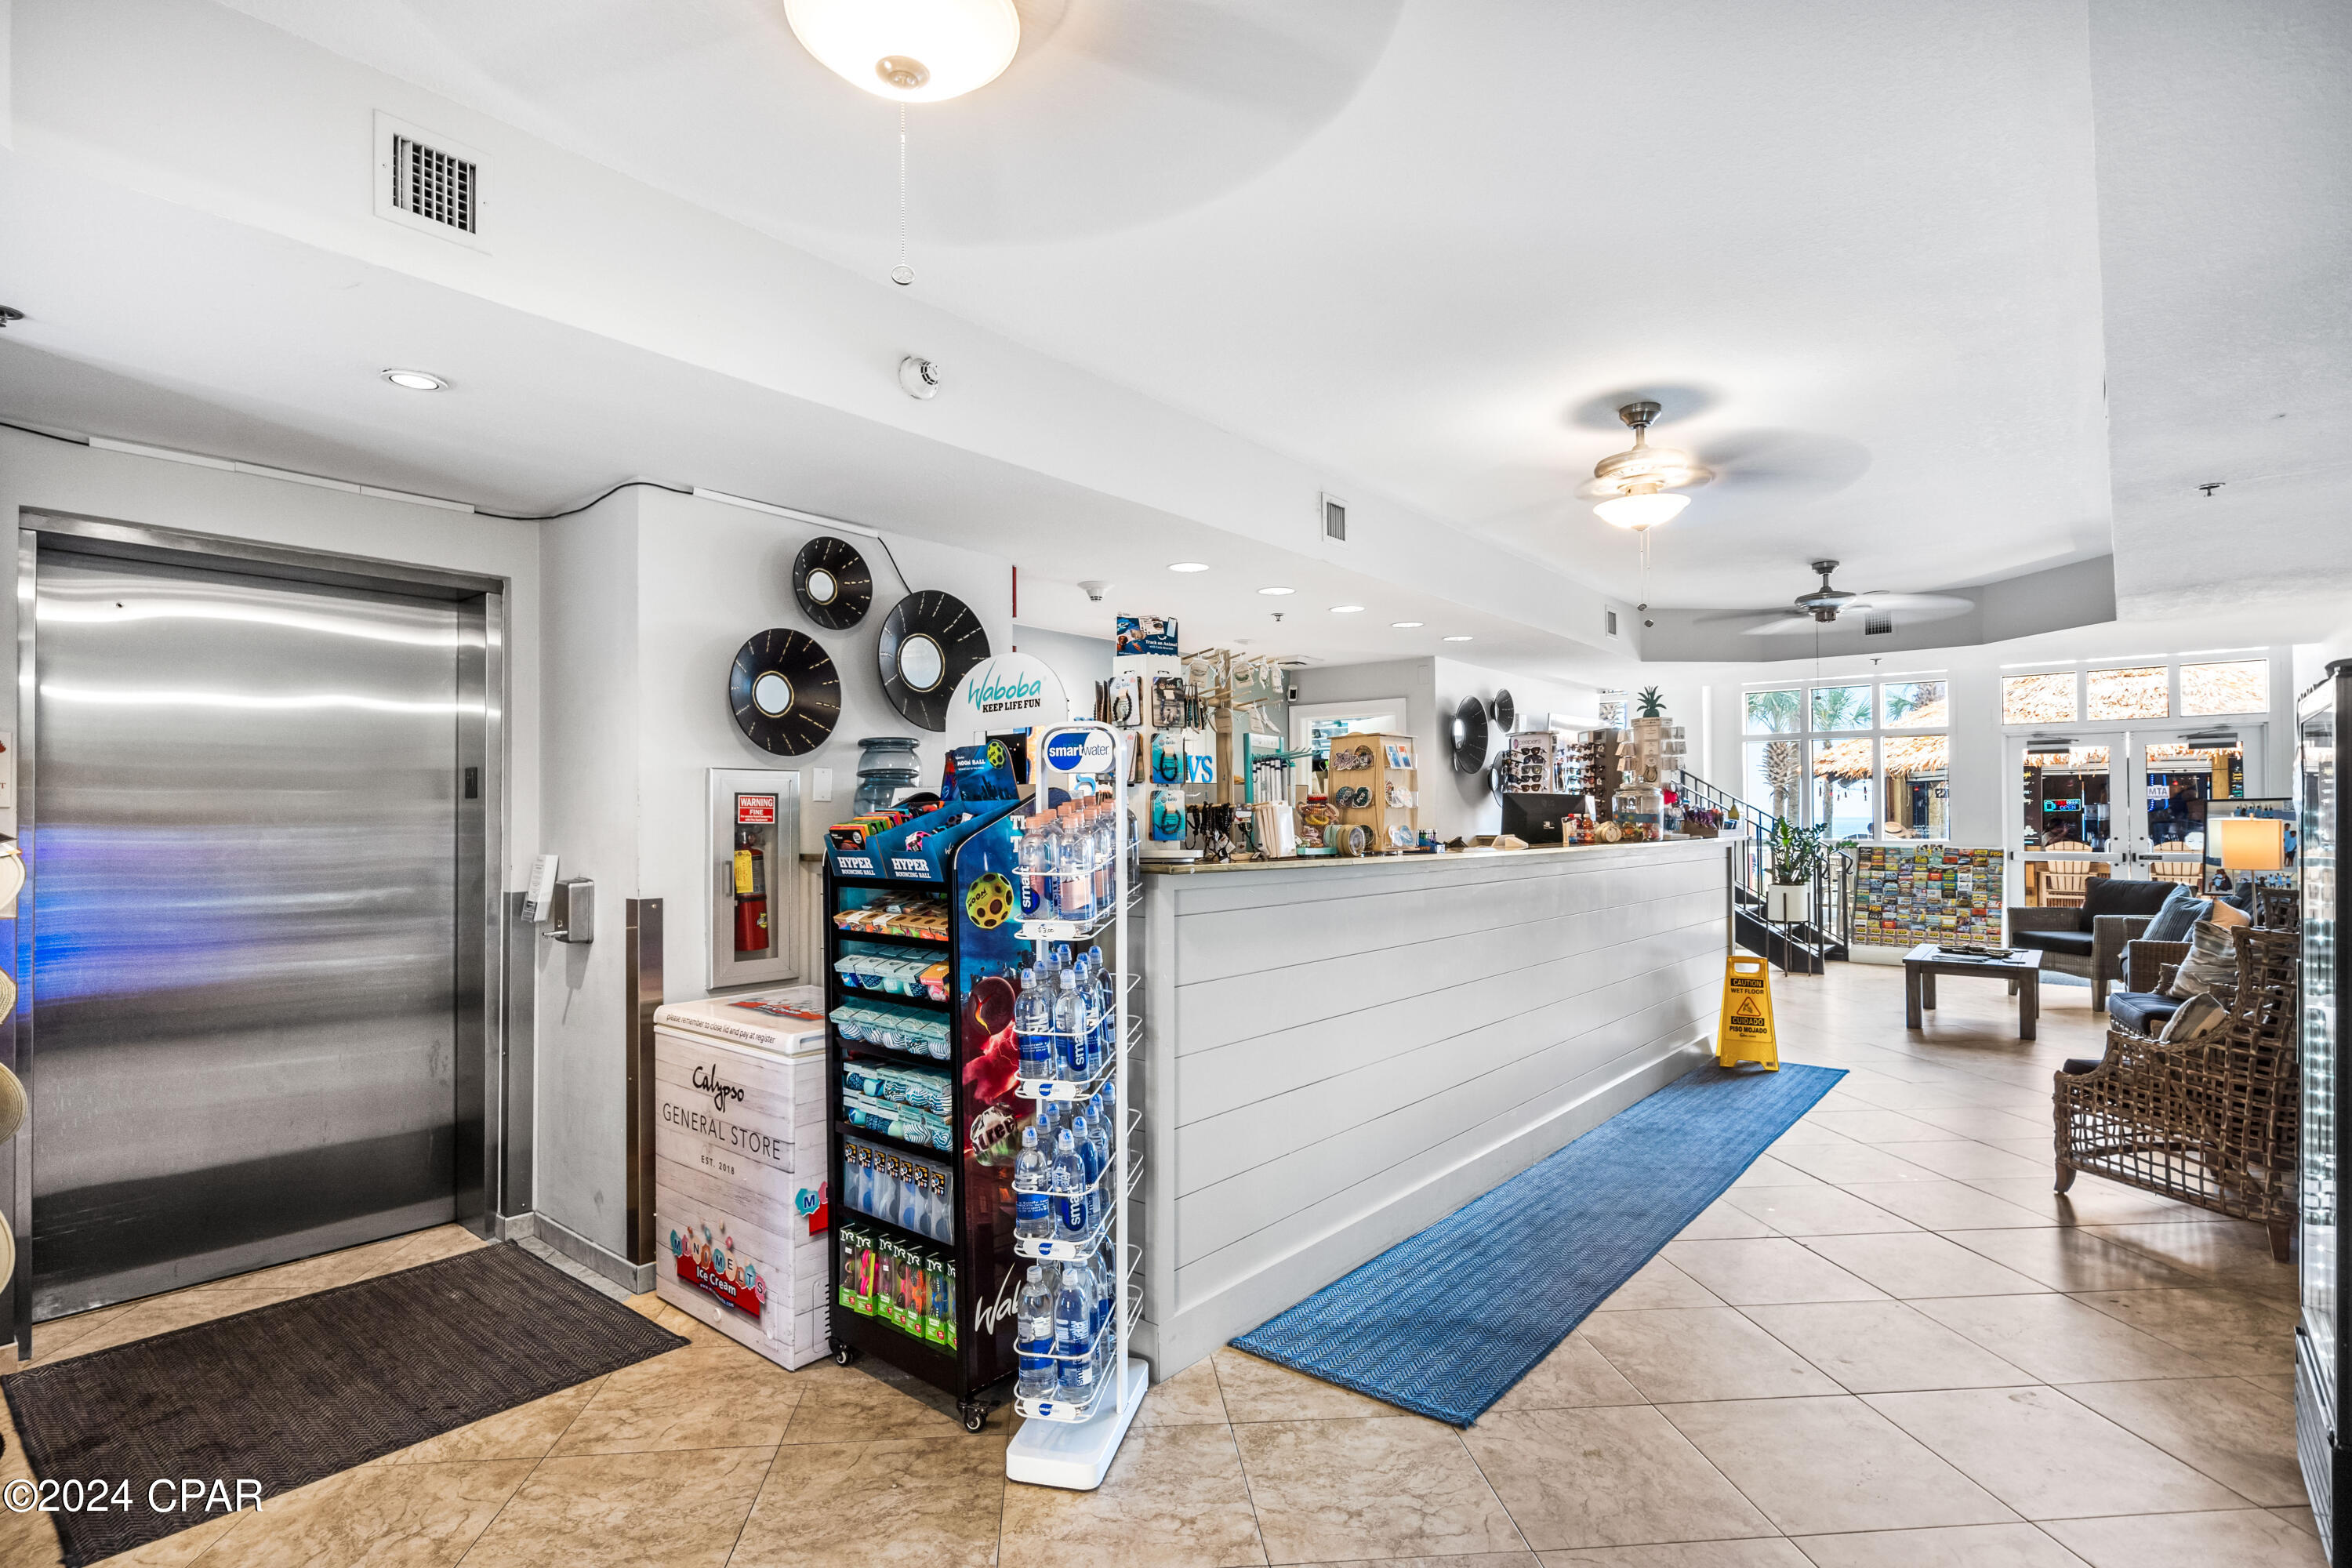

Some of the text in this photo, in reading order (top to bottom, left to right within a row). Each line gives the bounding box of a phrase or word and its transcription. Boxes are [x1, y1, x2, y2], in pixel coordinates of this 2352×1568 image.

[968, 658, 1041, 711] Waboba
[982, 699, 1041, 713] KEEP LIFE FUN
[1049, 744, 1109, 757] smartwater
[740, 797, 773, 807] WARNING
[837, 856, 873, 869] HYPER
[891, 858, 929, 871] HYPER
[1021, 865, 1031, 908] smat
[1733, 978, 1762, 987] CAUTION
[1733, 1017, 1763, 1025] CUIDADO
[681, 1017, 705, 1029] remember
[710, 1023, 722, 1033] close
[729, 1026, 739, 1036] and
[739, 1029, 748, 1040] pay
[756, 1033, 775, 1044] register
[693, 1063, 745, 1113] Calypso
[662, 1102, 780, 1160] GENERAL STORE
[701, 1155, 735, 1174] EST. 2018
[840, 1230, 855, 1241] TYR
[856, 1236, 871, 1248] TYR
[879, 1239, 892, 1251] TYR
[893, 1245, 906, 1258] TYR
[907, 1253, 920, 1266] TYR
[927, 1258, 942, 1272] TYR
[674, 1239, 763, 1294] MINI MELTS
[696, 1265, 708, 1282] Ice
[710, 1273, 736, 1296] Cream
